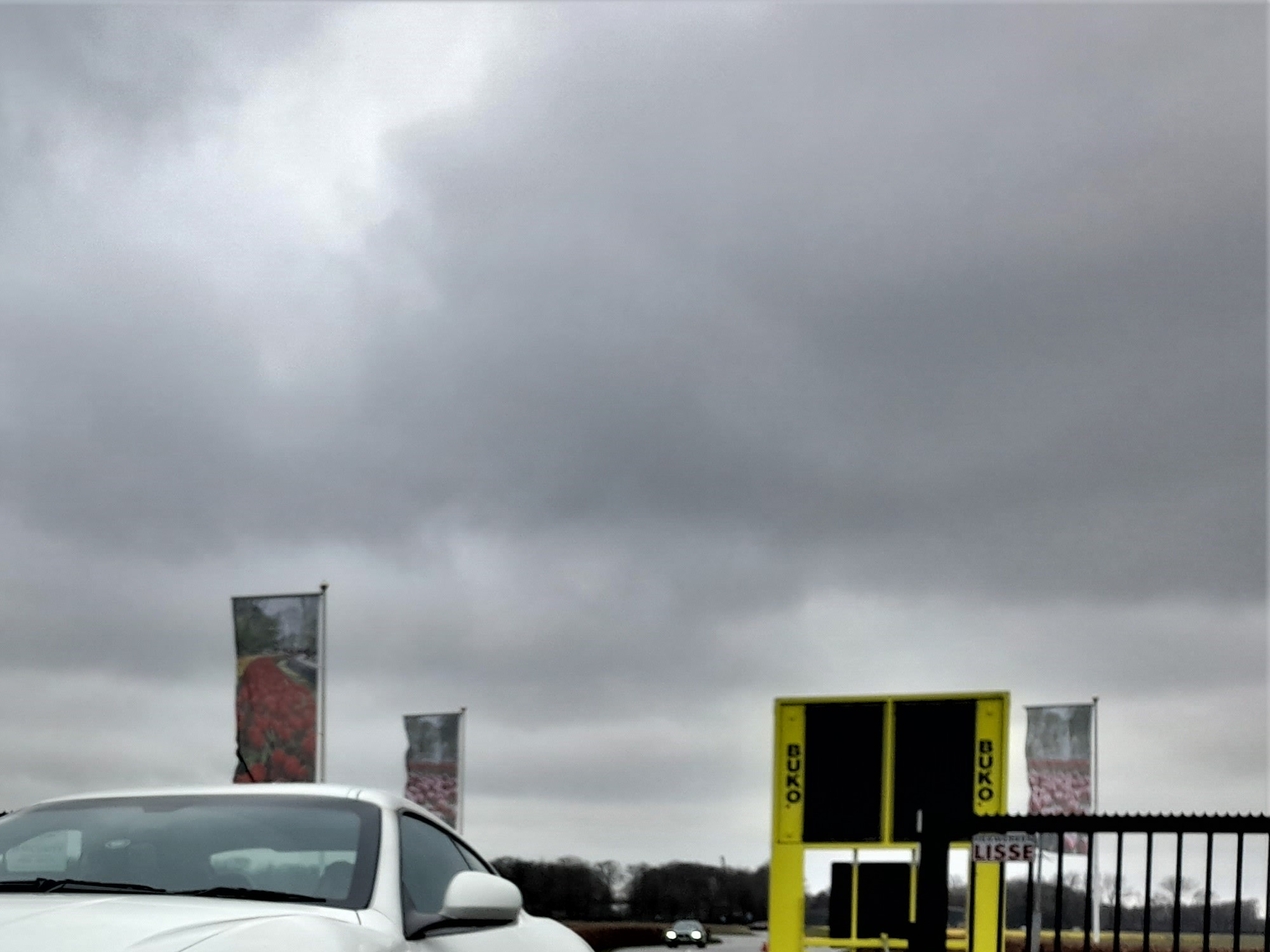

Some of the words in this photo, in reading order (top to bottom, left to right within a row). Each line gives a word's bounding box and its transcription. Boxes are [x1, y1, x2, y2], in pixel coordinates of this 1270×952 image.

[787, 743, 801, 803] BUKO
[979, 740, 994, 801] BUKO
[974, 843, 1034, 861] LISSE
